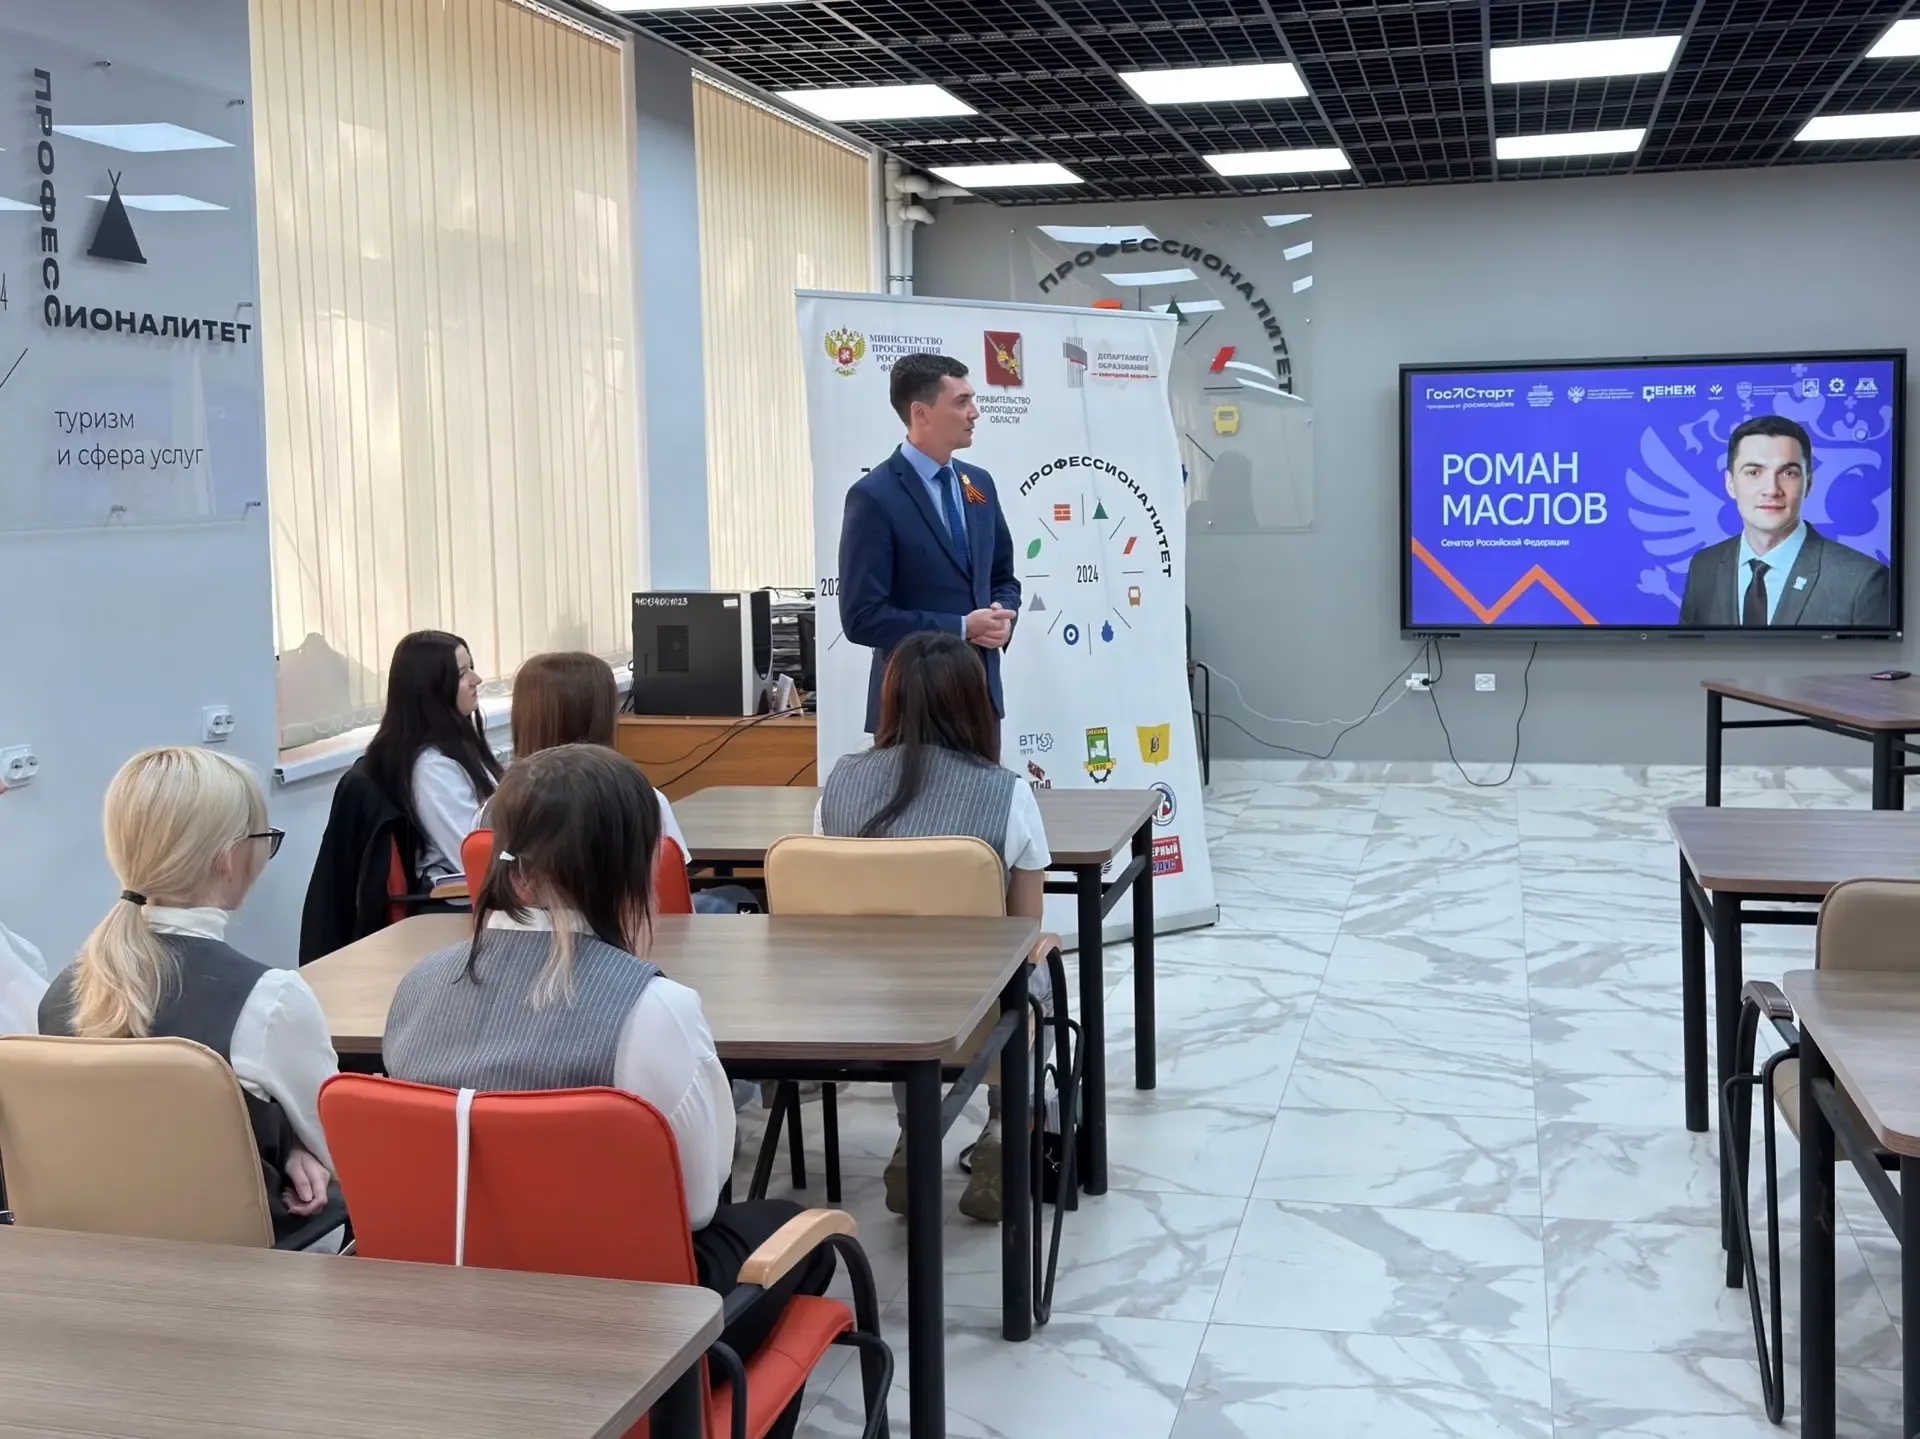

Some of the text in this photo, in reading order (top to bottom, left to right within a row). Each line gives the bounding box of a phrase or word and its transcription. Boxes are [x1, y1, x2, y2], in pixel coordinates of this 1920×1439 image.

[1038, 238, 1293, 395] ПРОФЕССИОНАЛИТЕТ
[869, 334, 943, 346] МИНИСТЕРСТВО
[976, 395, 1031, 404] ПРАВИТЕЛЬСТВО
[980, 405, 1028, 415] ВОЛОГОДСКОЙ
[990, 415, 1020, 424] ОБЛАСТИ
[55, 408, 135, 432] туризм
[57, 442, 204, 470] и сфера услуг
[1443, 451, 1578, 485] РОМАН
[1019, 455, 1172, 577] ПРОФЕССИОНАЛИТЕТ
[1443, 492, 1608, 526] МАСЛОВ
[1441, 537, 1570, 548] Сенатор Российской Федерации
[1076, 564, 1099, 583] 2024
[820, 578, 840, 597] 202
